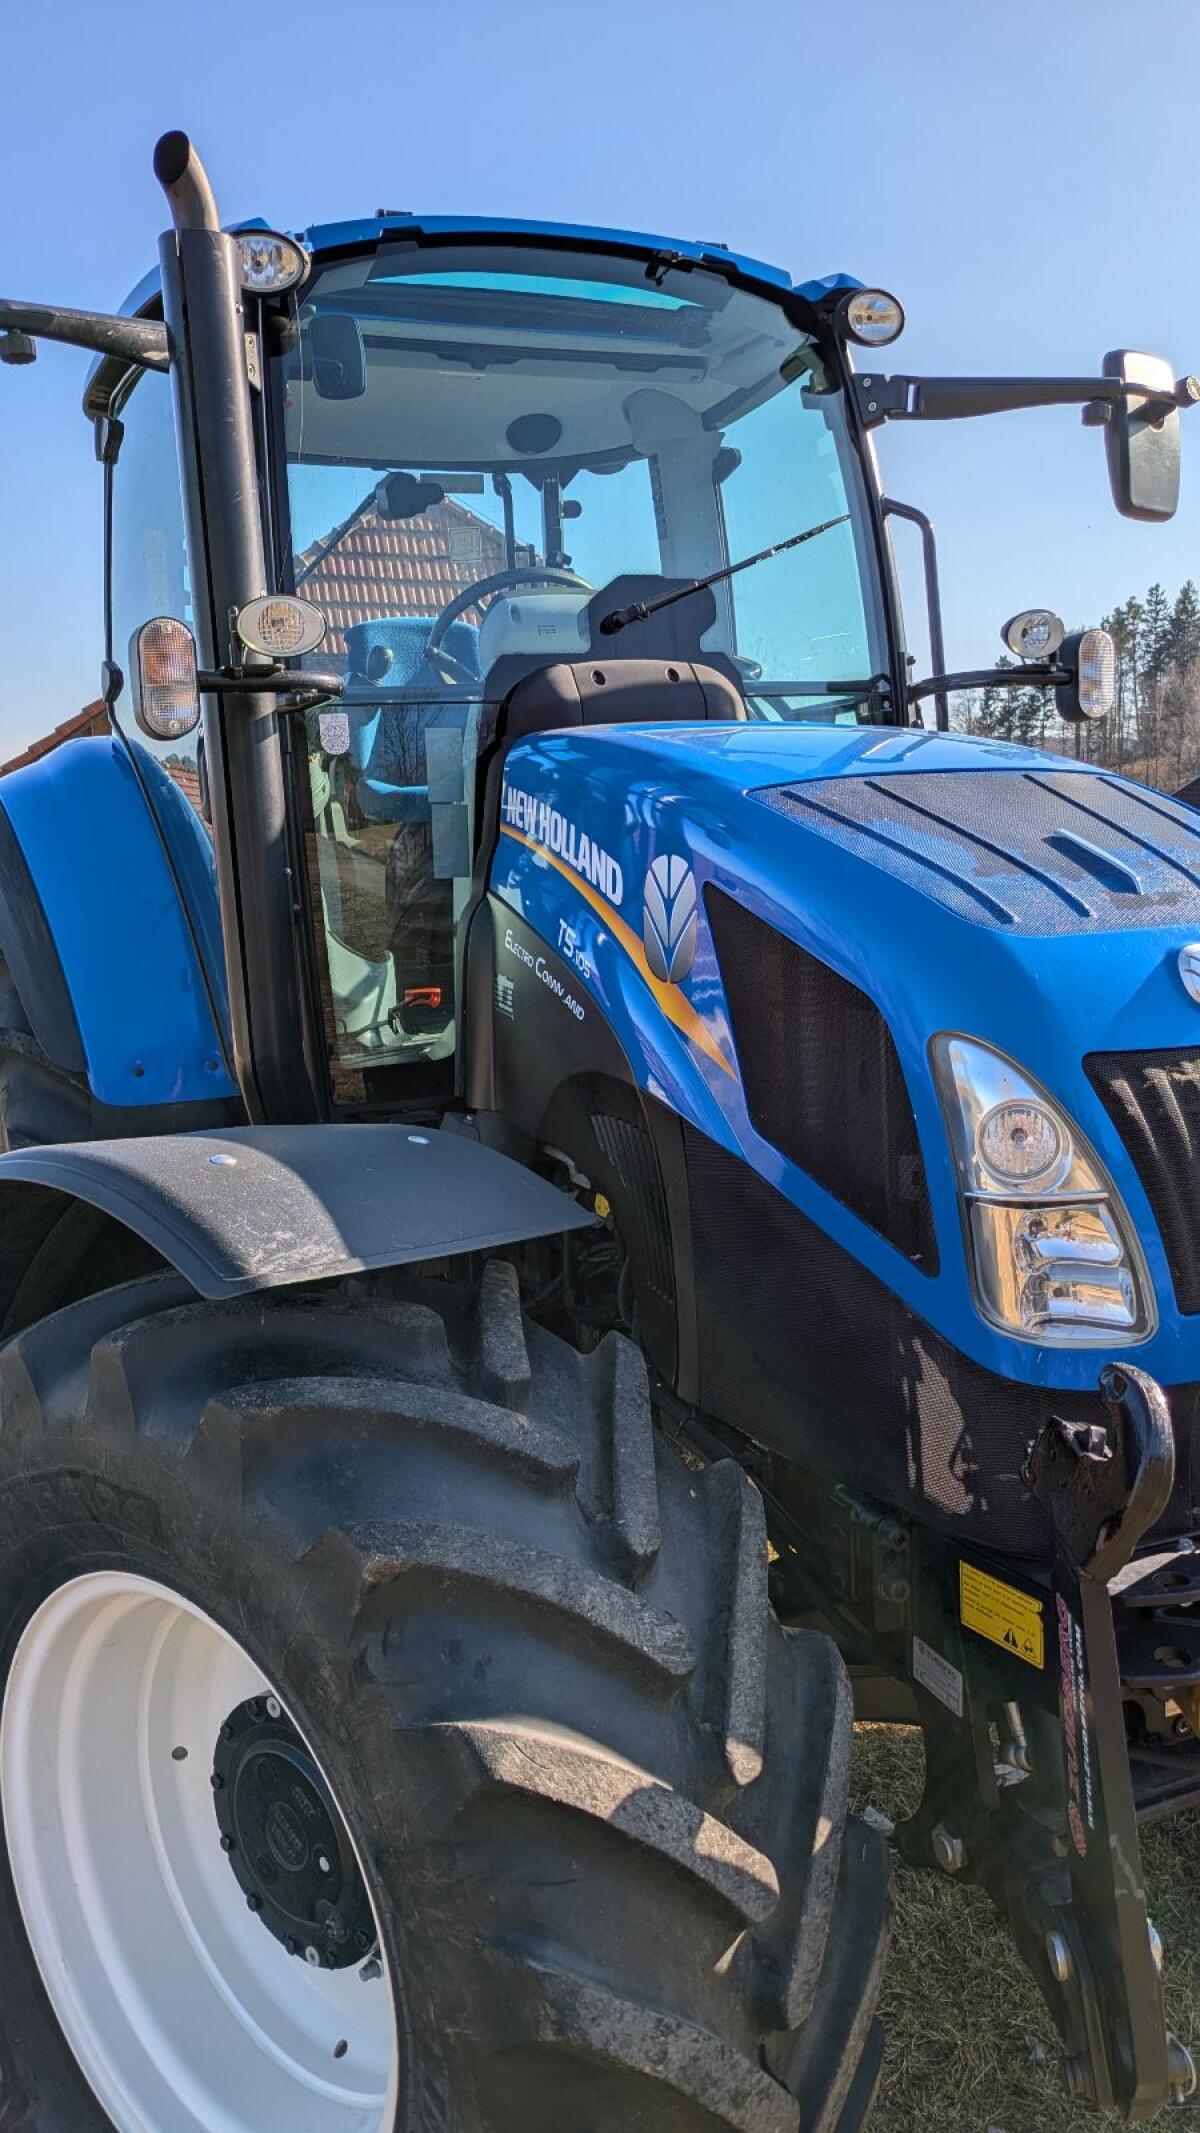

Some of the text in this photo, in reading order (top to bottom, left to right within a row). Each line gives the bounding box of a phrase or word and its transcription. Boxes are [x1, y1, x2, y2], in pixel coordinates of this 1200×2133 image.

[506, 786, 624, 906] NEW HOLLAND
[558, 918, 591, 980] T5.105
